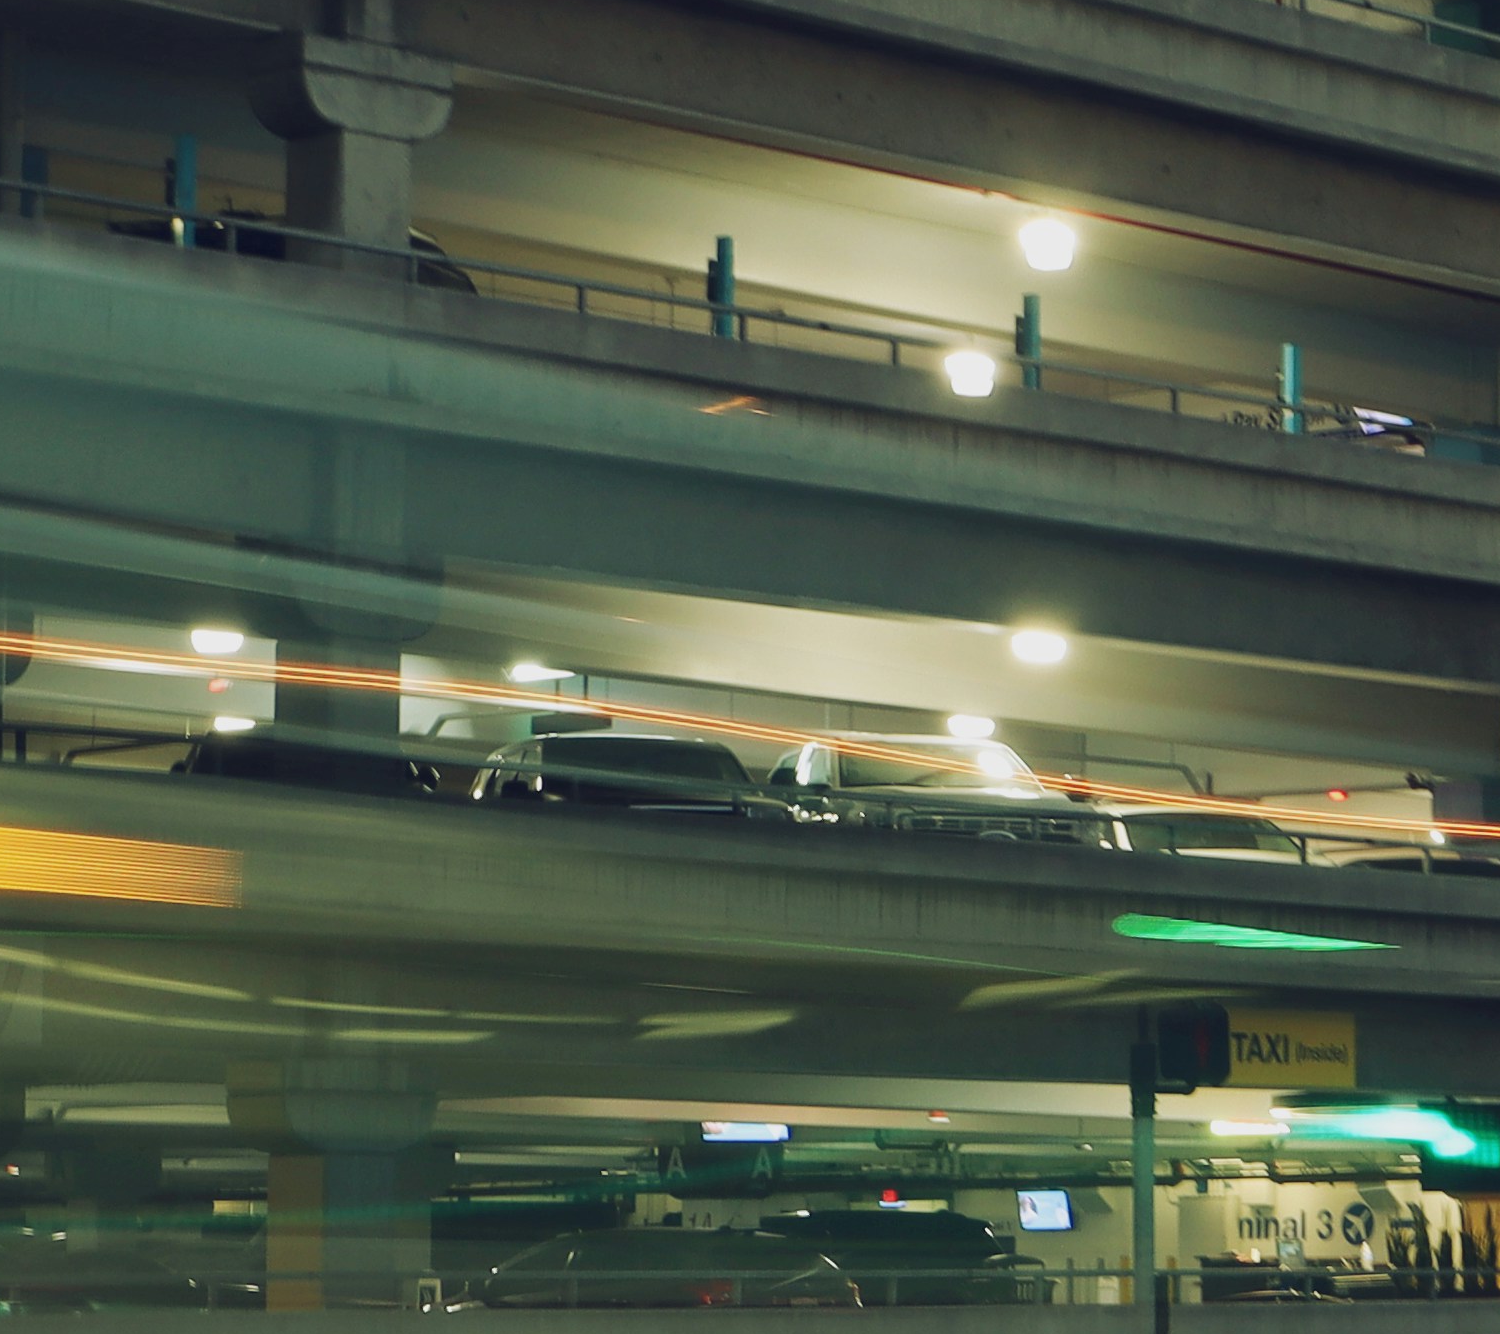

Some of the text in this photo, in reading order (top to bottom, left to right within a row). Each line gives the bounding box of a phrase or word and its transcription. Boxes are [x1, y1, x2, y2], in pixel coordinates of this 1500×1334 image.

[1231, 1032, 1290, 1063] TAXI
[668, 1146, 687, 1178] A
[752, 1146, 773, 1178] A
[1317, 1209, 1333, 1240] 3
